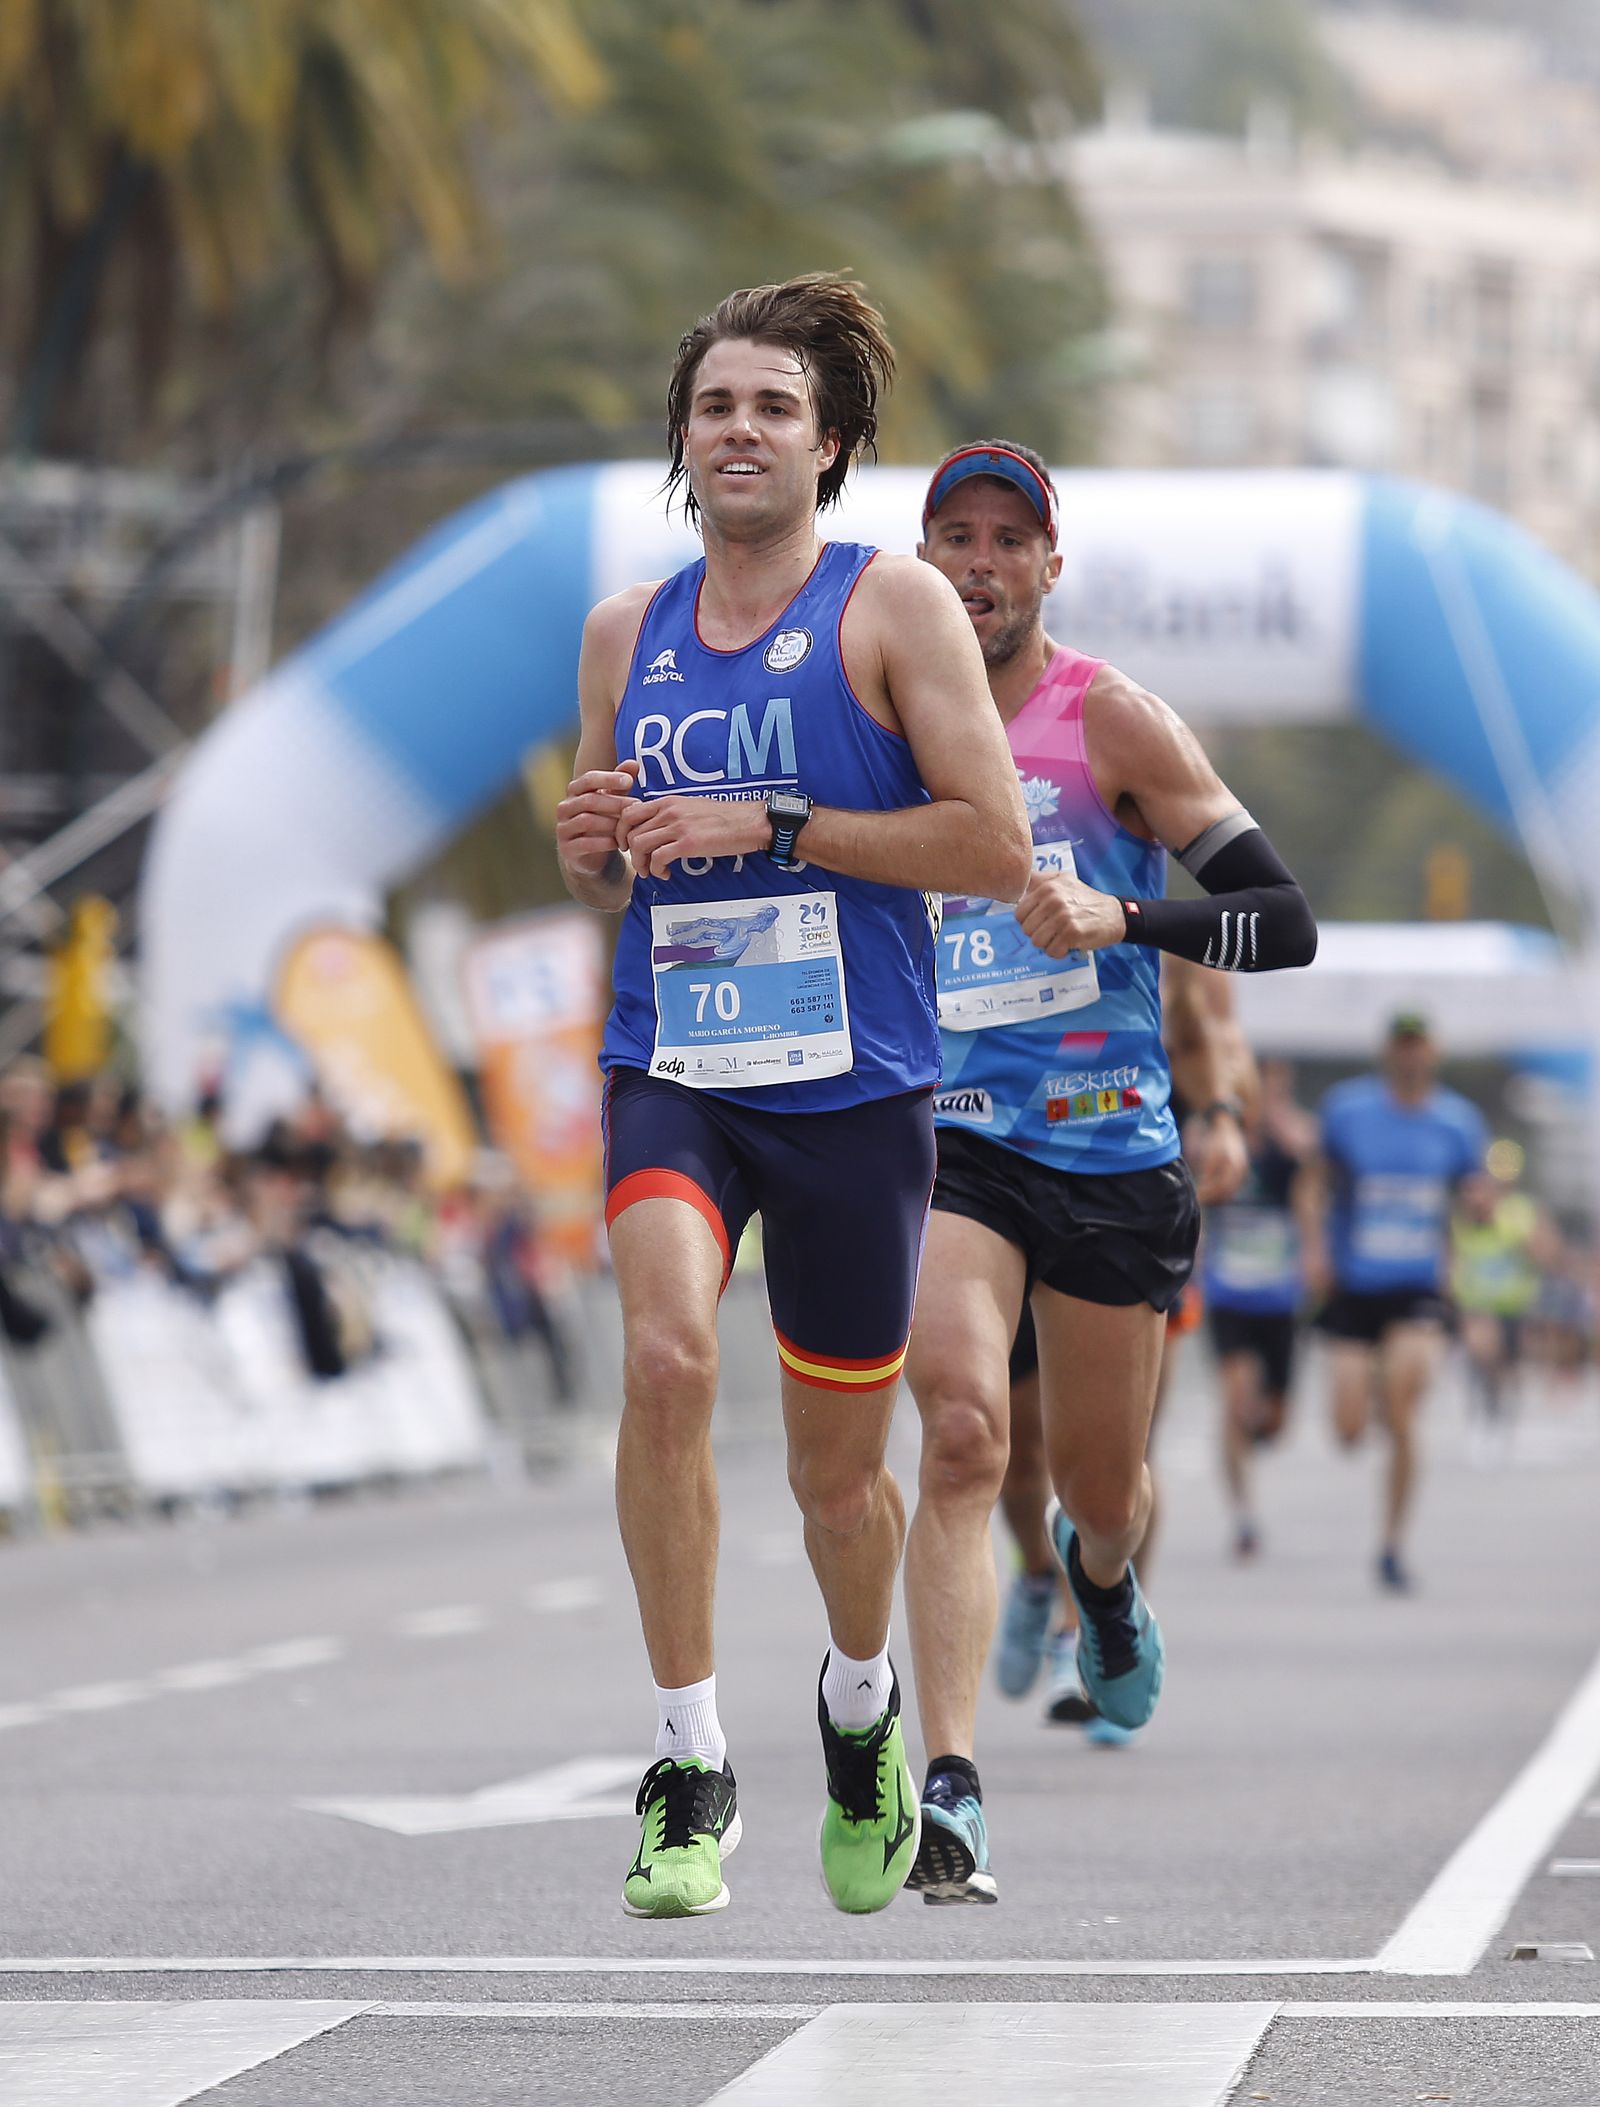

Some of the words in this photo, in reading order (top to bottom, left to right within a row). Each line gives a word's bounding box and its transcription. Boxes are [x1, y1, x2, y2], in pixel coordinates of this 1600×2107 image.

[771, 640, 802, 655] RCM
[635, 698, 798, 788] RCM
[799, 902, 826, 924] 29
[944, 929, 995, 970] 78
[689, 982, 740, 1022] 70
[688, 1030, 710, 1038] MARIO
[711, 1026, 742, 1036] GARCÍA
[743, 1023, 780, 1033] MORENO
[656, 1057, 685, 1078] edp
